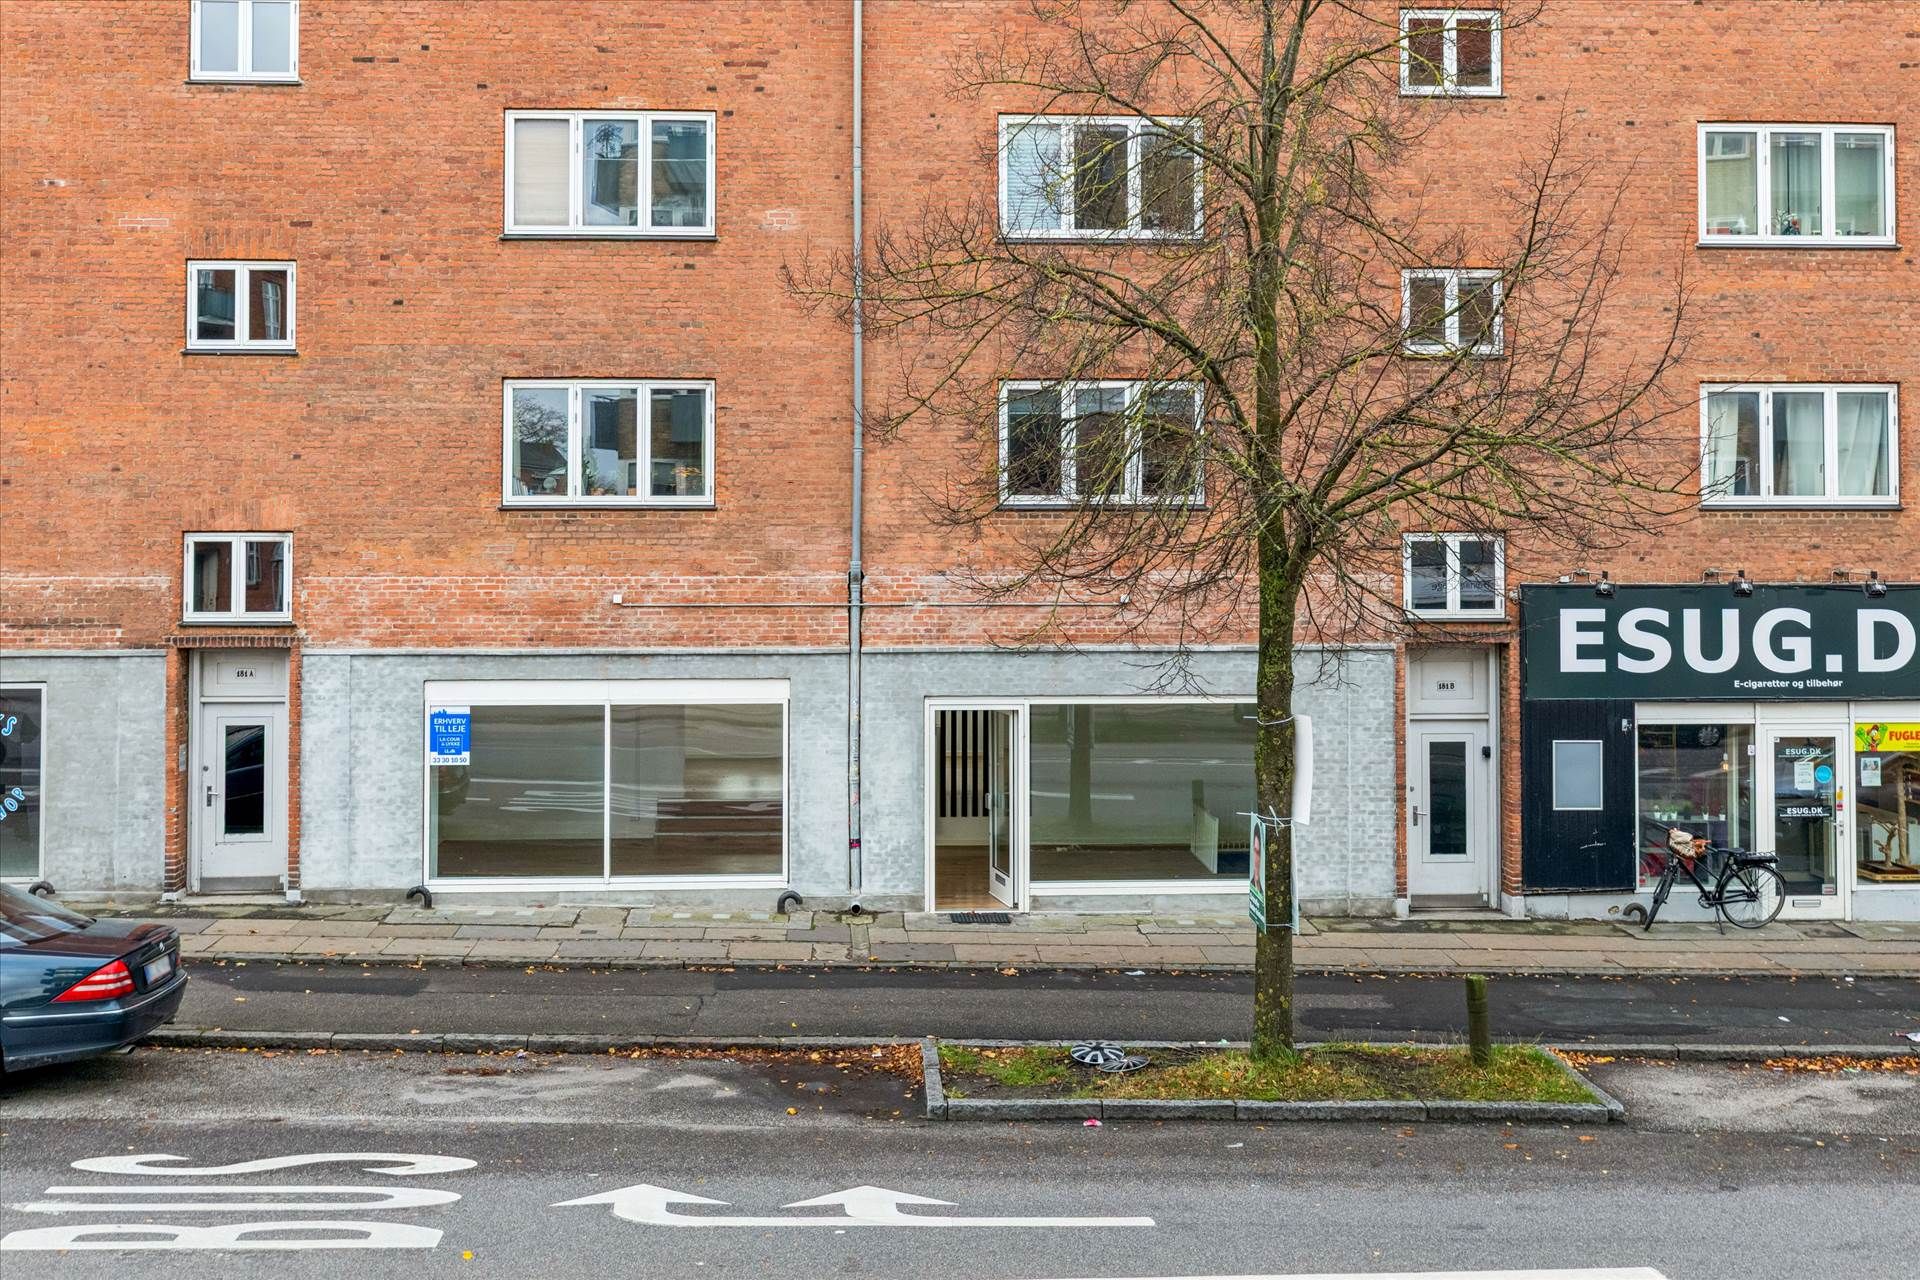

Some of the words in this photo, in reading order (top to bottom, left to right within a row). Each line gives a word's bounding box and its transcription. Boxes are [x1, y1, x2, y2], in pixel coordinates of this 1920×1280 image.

[1559, 607, 1917, 674] ESUG.D
[1734, 680, 1790, 690] E-cigaretter
[1792, 681, 1804, 689] og
[1806, 679, 1844, 688] tilbehør
[0, 1152, 478, 1250] BUS
